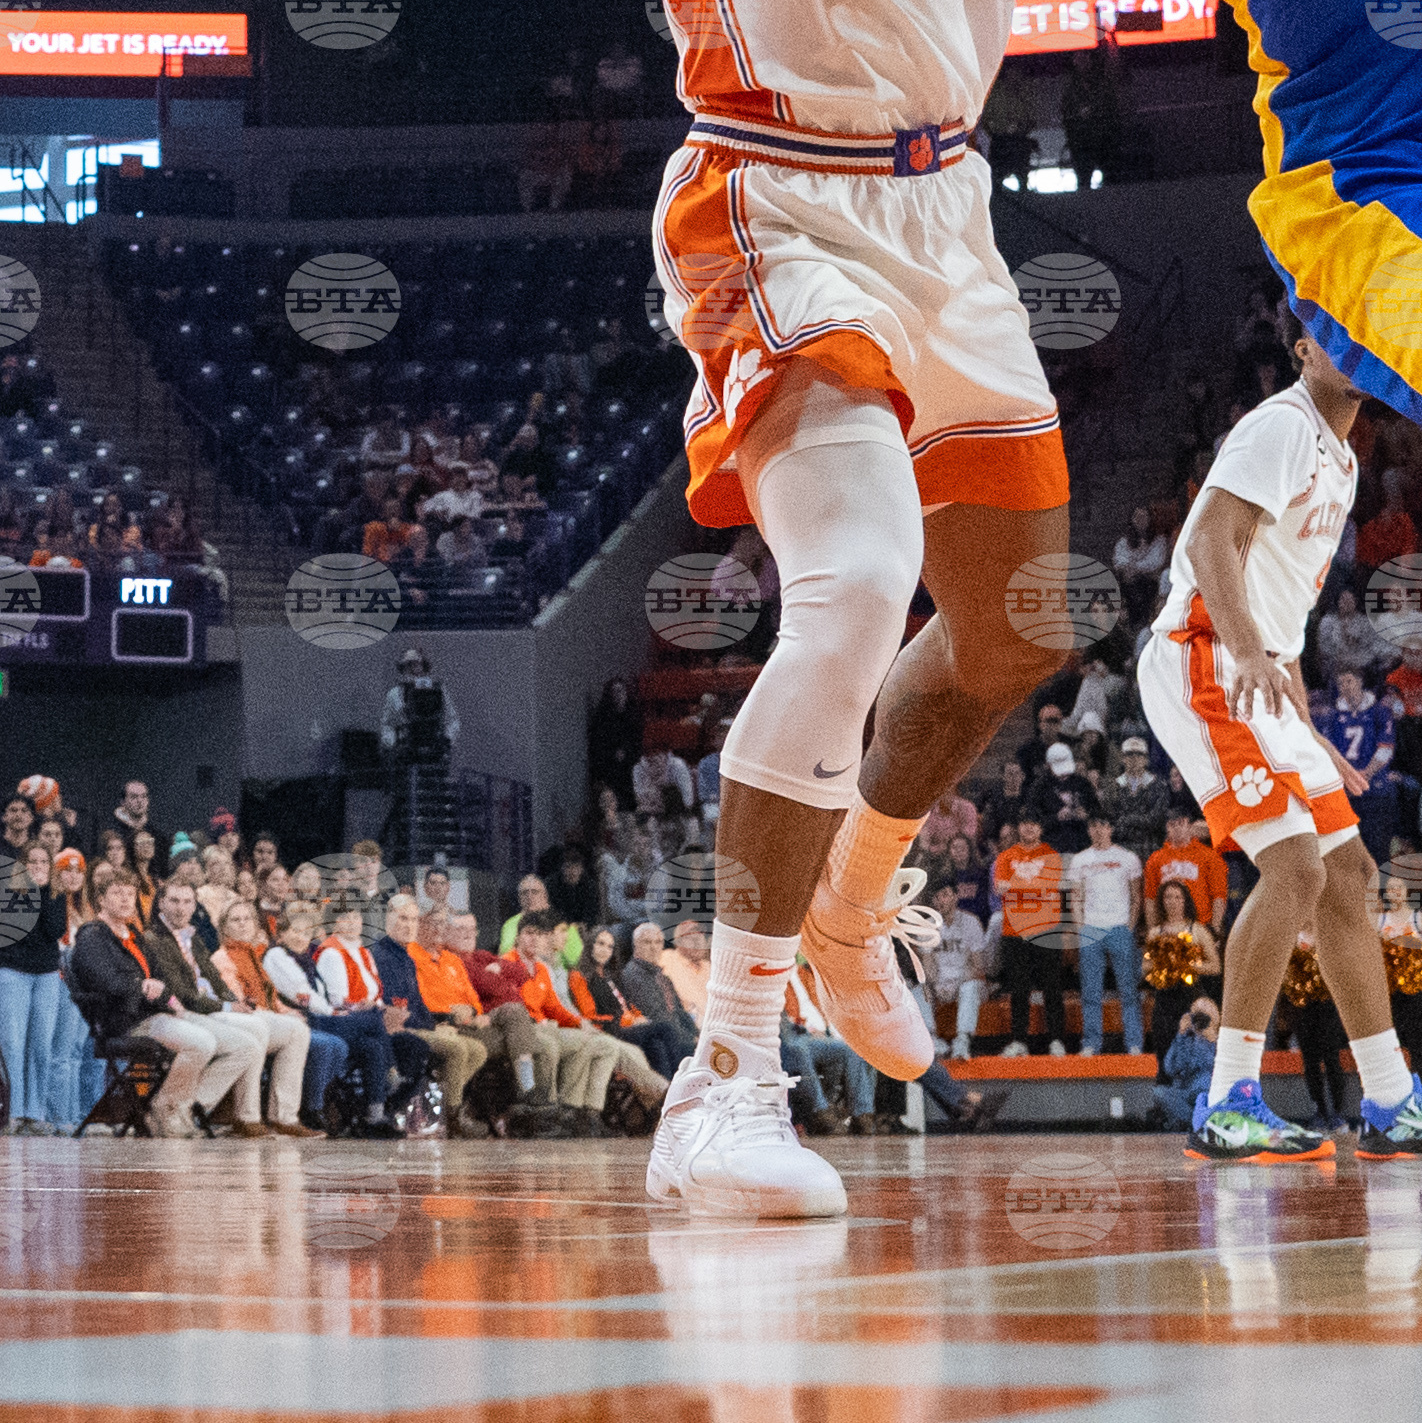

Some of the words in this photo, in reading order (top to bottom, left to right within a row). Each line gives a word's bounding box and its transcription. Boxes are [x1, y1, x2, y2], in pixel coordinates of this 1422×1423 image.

[1011, 4, 1053, 35] ET
[1059, 1, 1090, 31] IS
[7, 32, 75, 54] YOUR
[77, 33, 120, 55] JET
[123, 34, 146, 55] IS
[120, 577, 173, 605] PITT
[1343, 724, 1366, 760] 7
